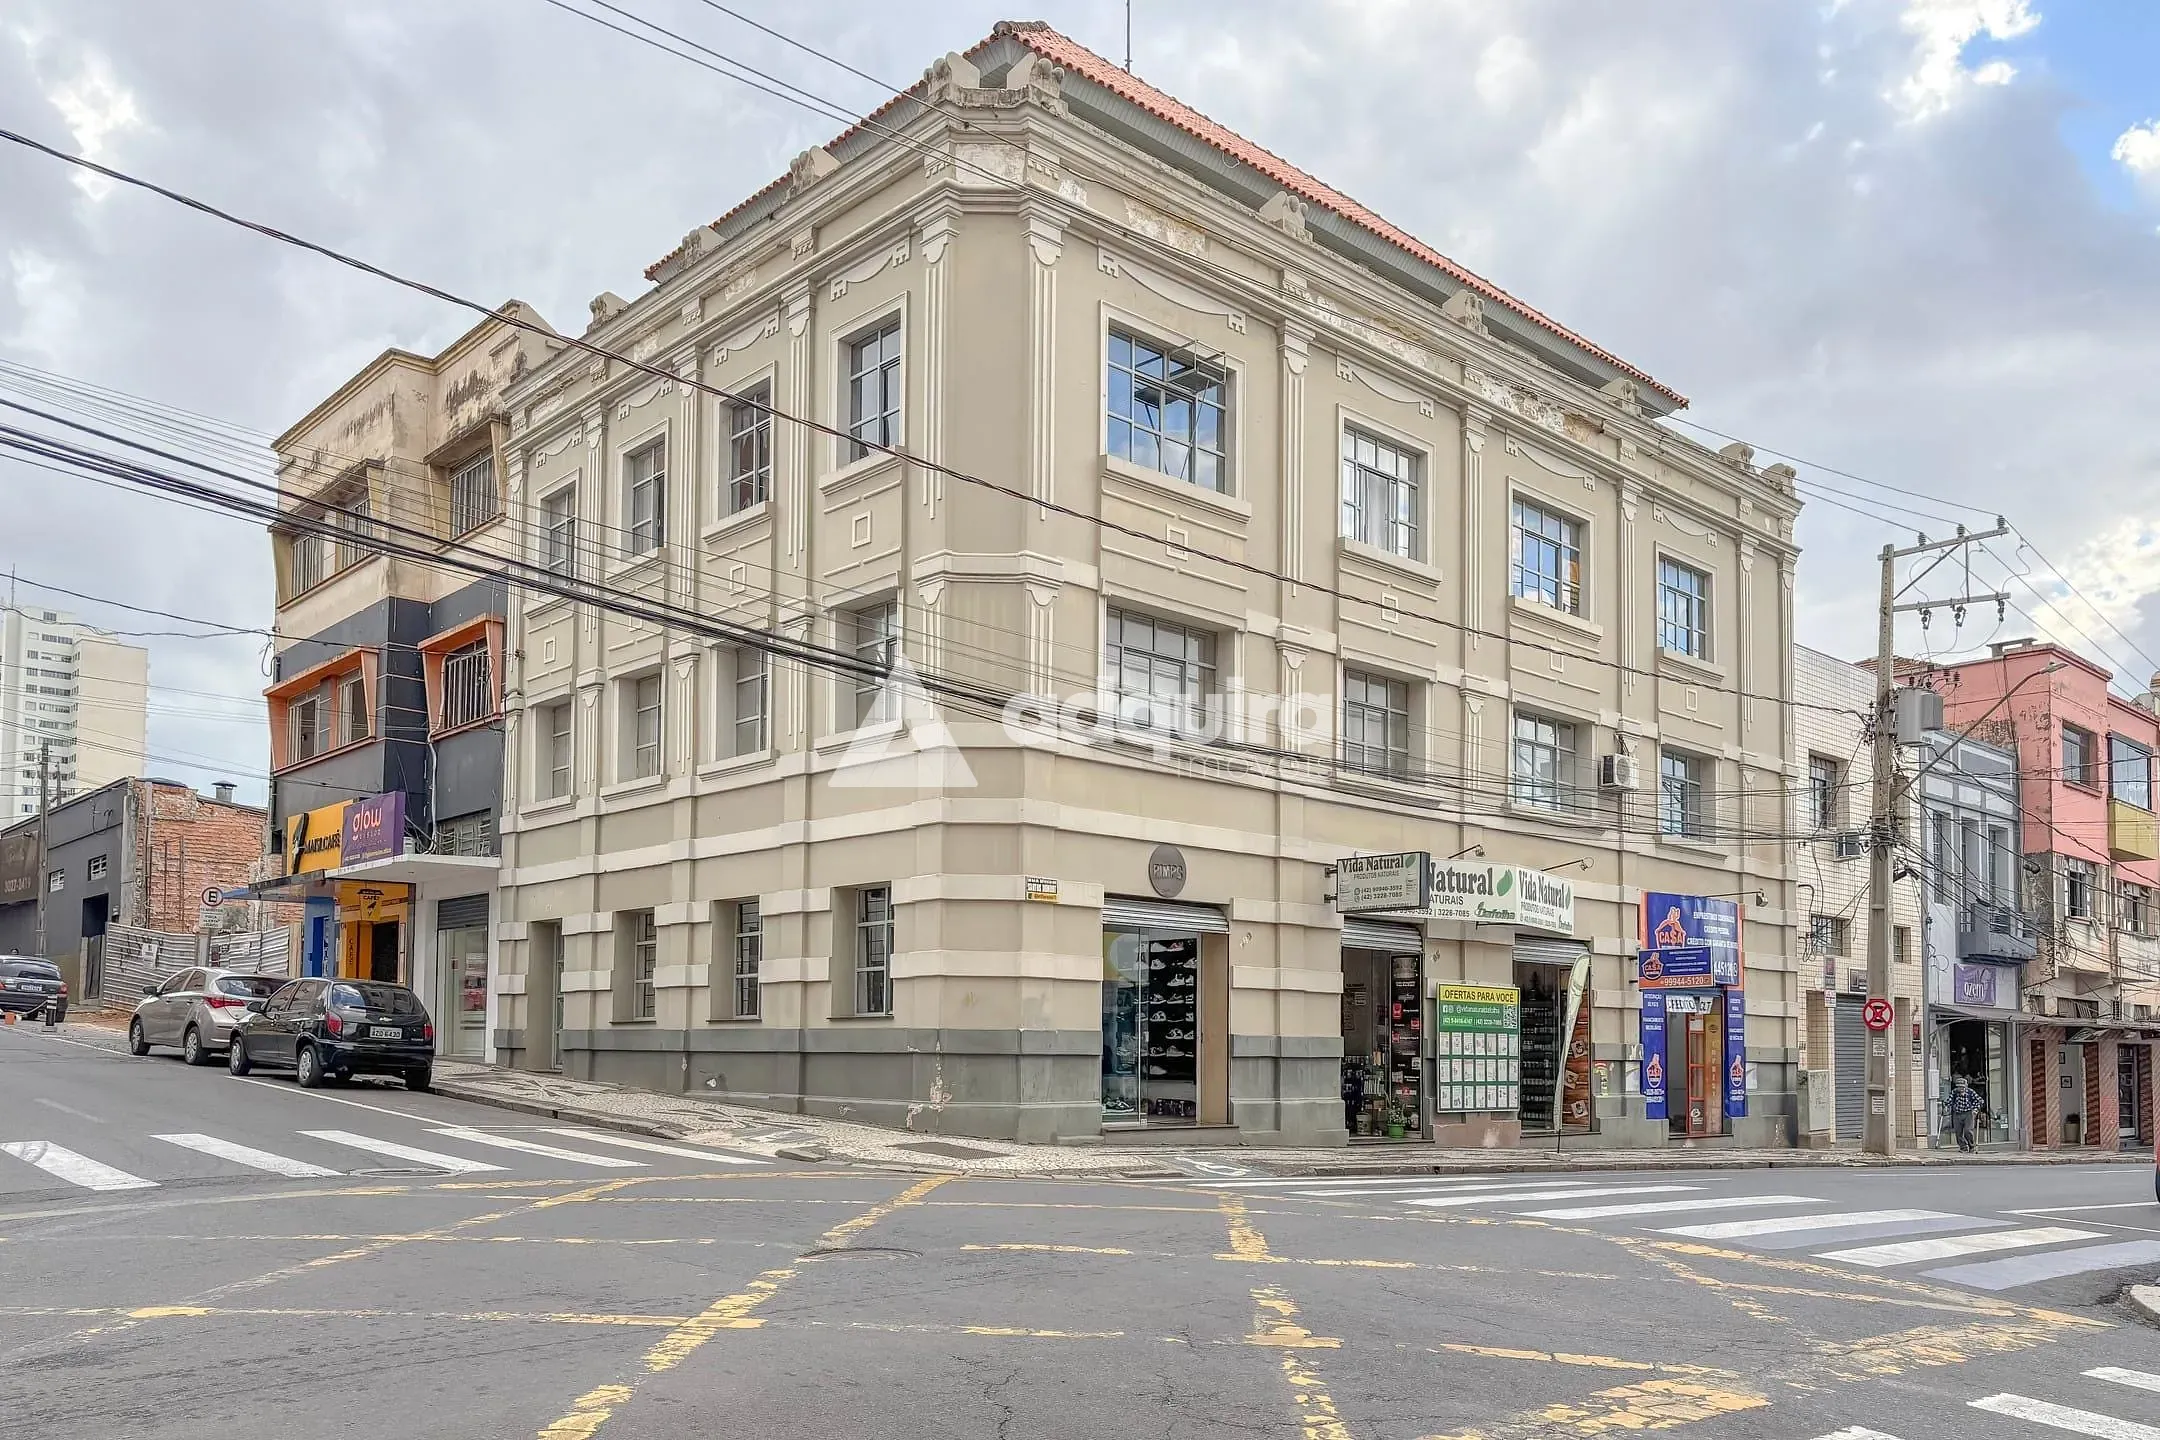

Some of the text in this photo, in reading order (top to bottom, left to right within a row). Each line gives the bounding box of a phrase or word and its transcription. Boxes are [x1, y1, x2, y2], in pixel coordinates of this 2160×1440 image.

[353, 804, 382, 832] glow
[1153, 863, 1183, 880] PIMPS
[1341, 854, 1404, 873] Vida Natural
[1429, 862, 1493, 896] Natural
[208, 891, 217, 902] E
[1519, 870, 1564, 909] Vida Natural
[1429, 894, 1464, 905] ATURAIS
[1664, 976, 1704, 986] 99944-5120
[1444, 989, 1514, 1003] OFERTAS PARA VOCÊ
